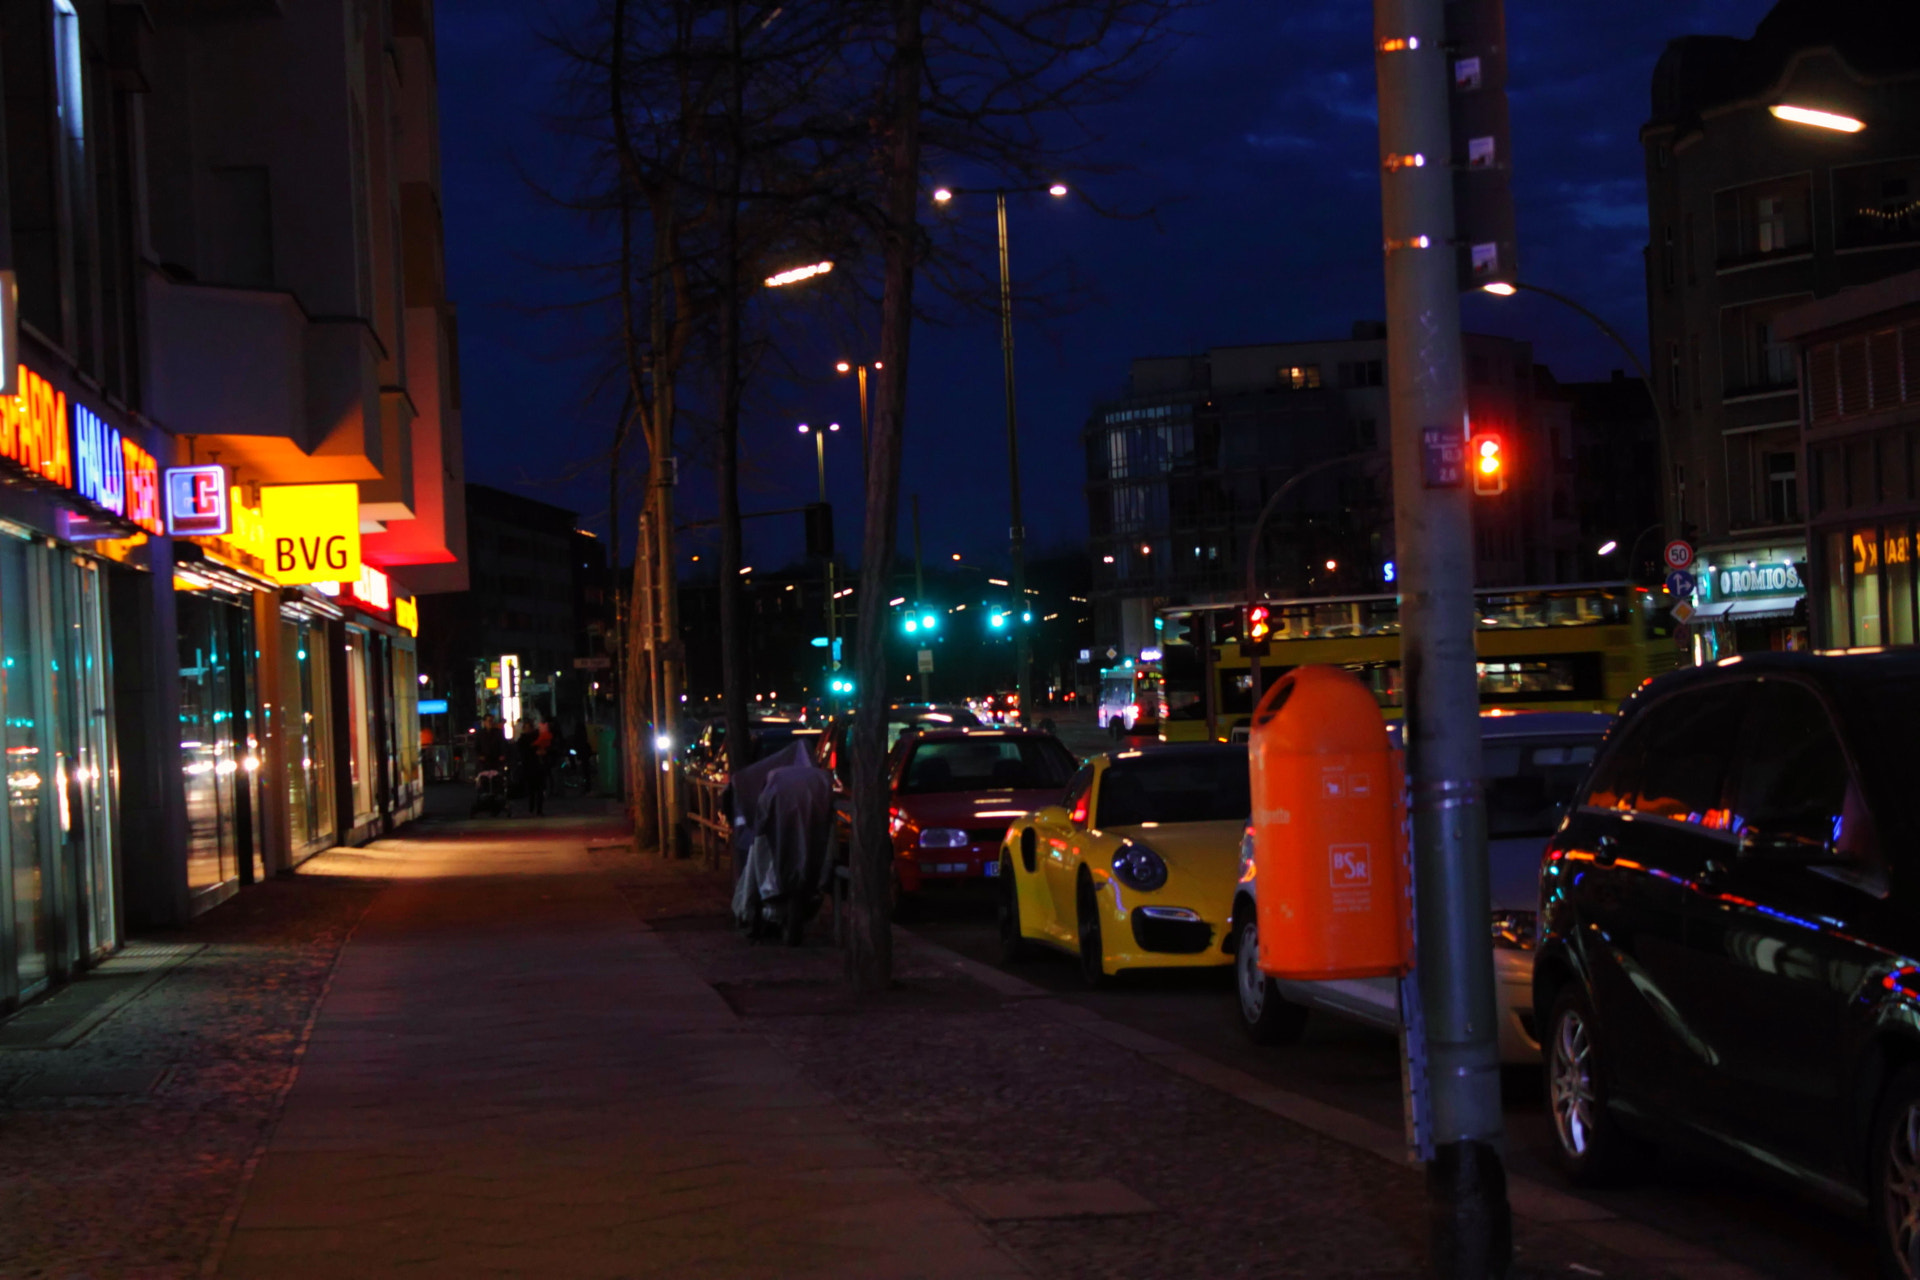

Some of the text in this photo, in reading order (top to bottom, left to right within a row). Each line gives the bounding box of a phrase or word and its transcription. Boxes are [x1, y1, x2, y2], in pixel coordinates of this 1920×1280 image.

[75, 402, 124, 517] HALLO
[275, 535, 348, 572] BVG
[1670, 548, 1687, 558] 50
[1731, 566, 1799, 592] ROMIOS
[1333, 852, 1367, 880] BSR
